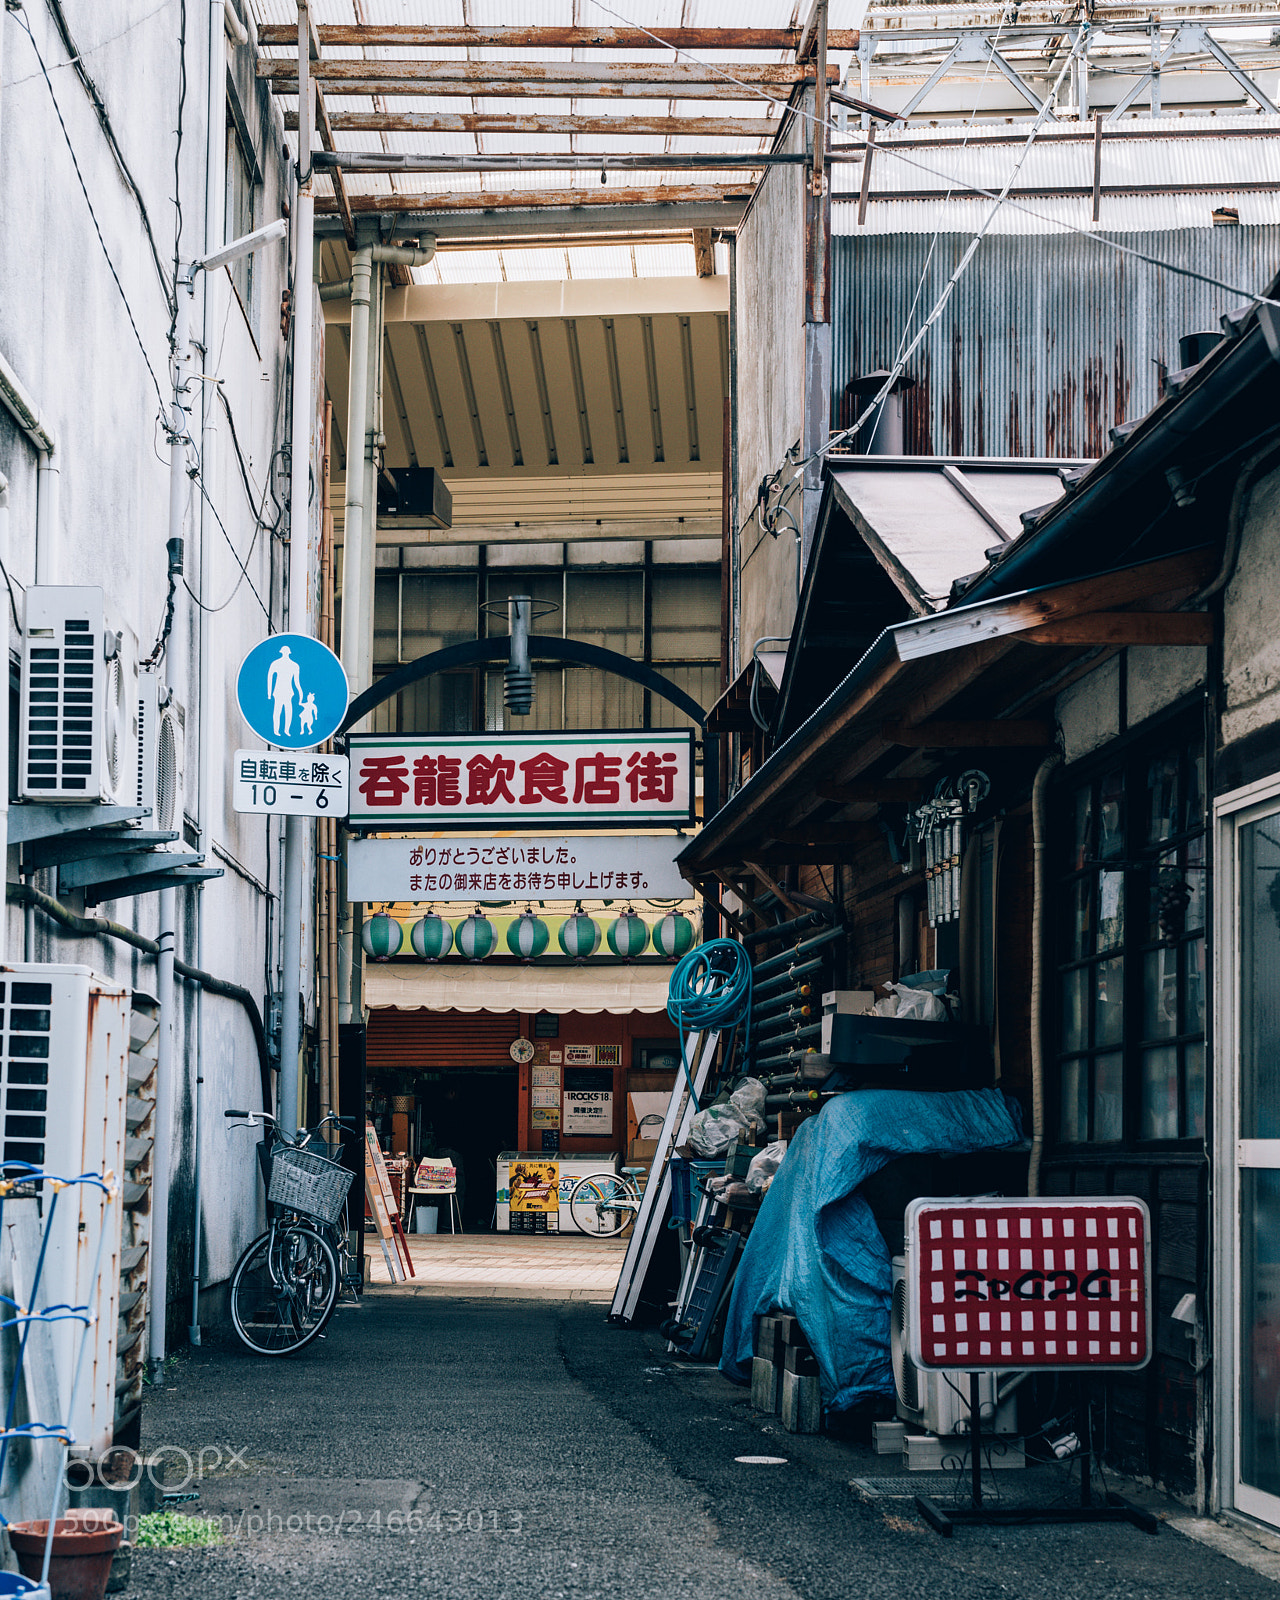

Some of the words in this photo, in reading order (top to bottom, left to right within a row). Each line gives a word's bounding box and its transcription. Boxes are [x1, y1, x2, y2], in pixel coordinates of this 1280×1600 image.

[240, 758, 342, 784] 自転車を除く
[359, 751, 678, 807] 呑龍飲食店街
[409, 846, 577, 867] ありがとうございました。
[409, 870, 649, 891] またの御来店をお待ち申し上げます。
